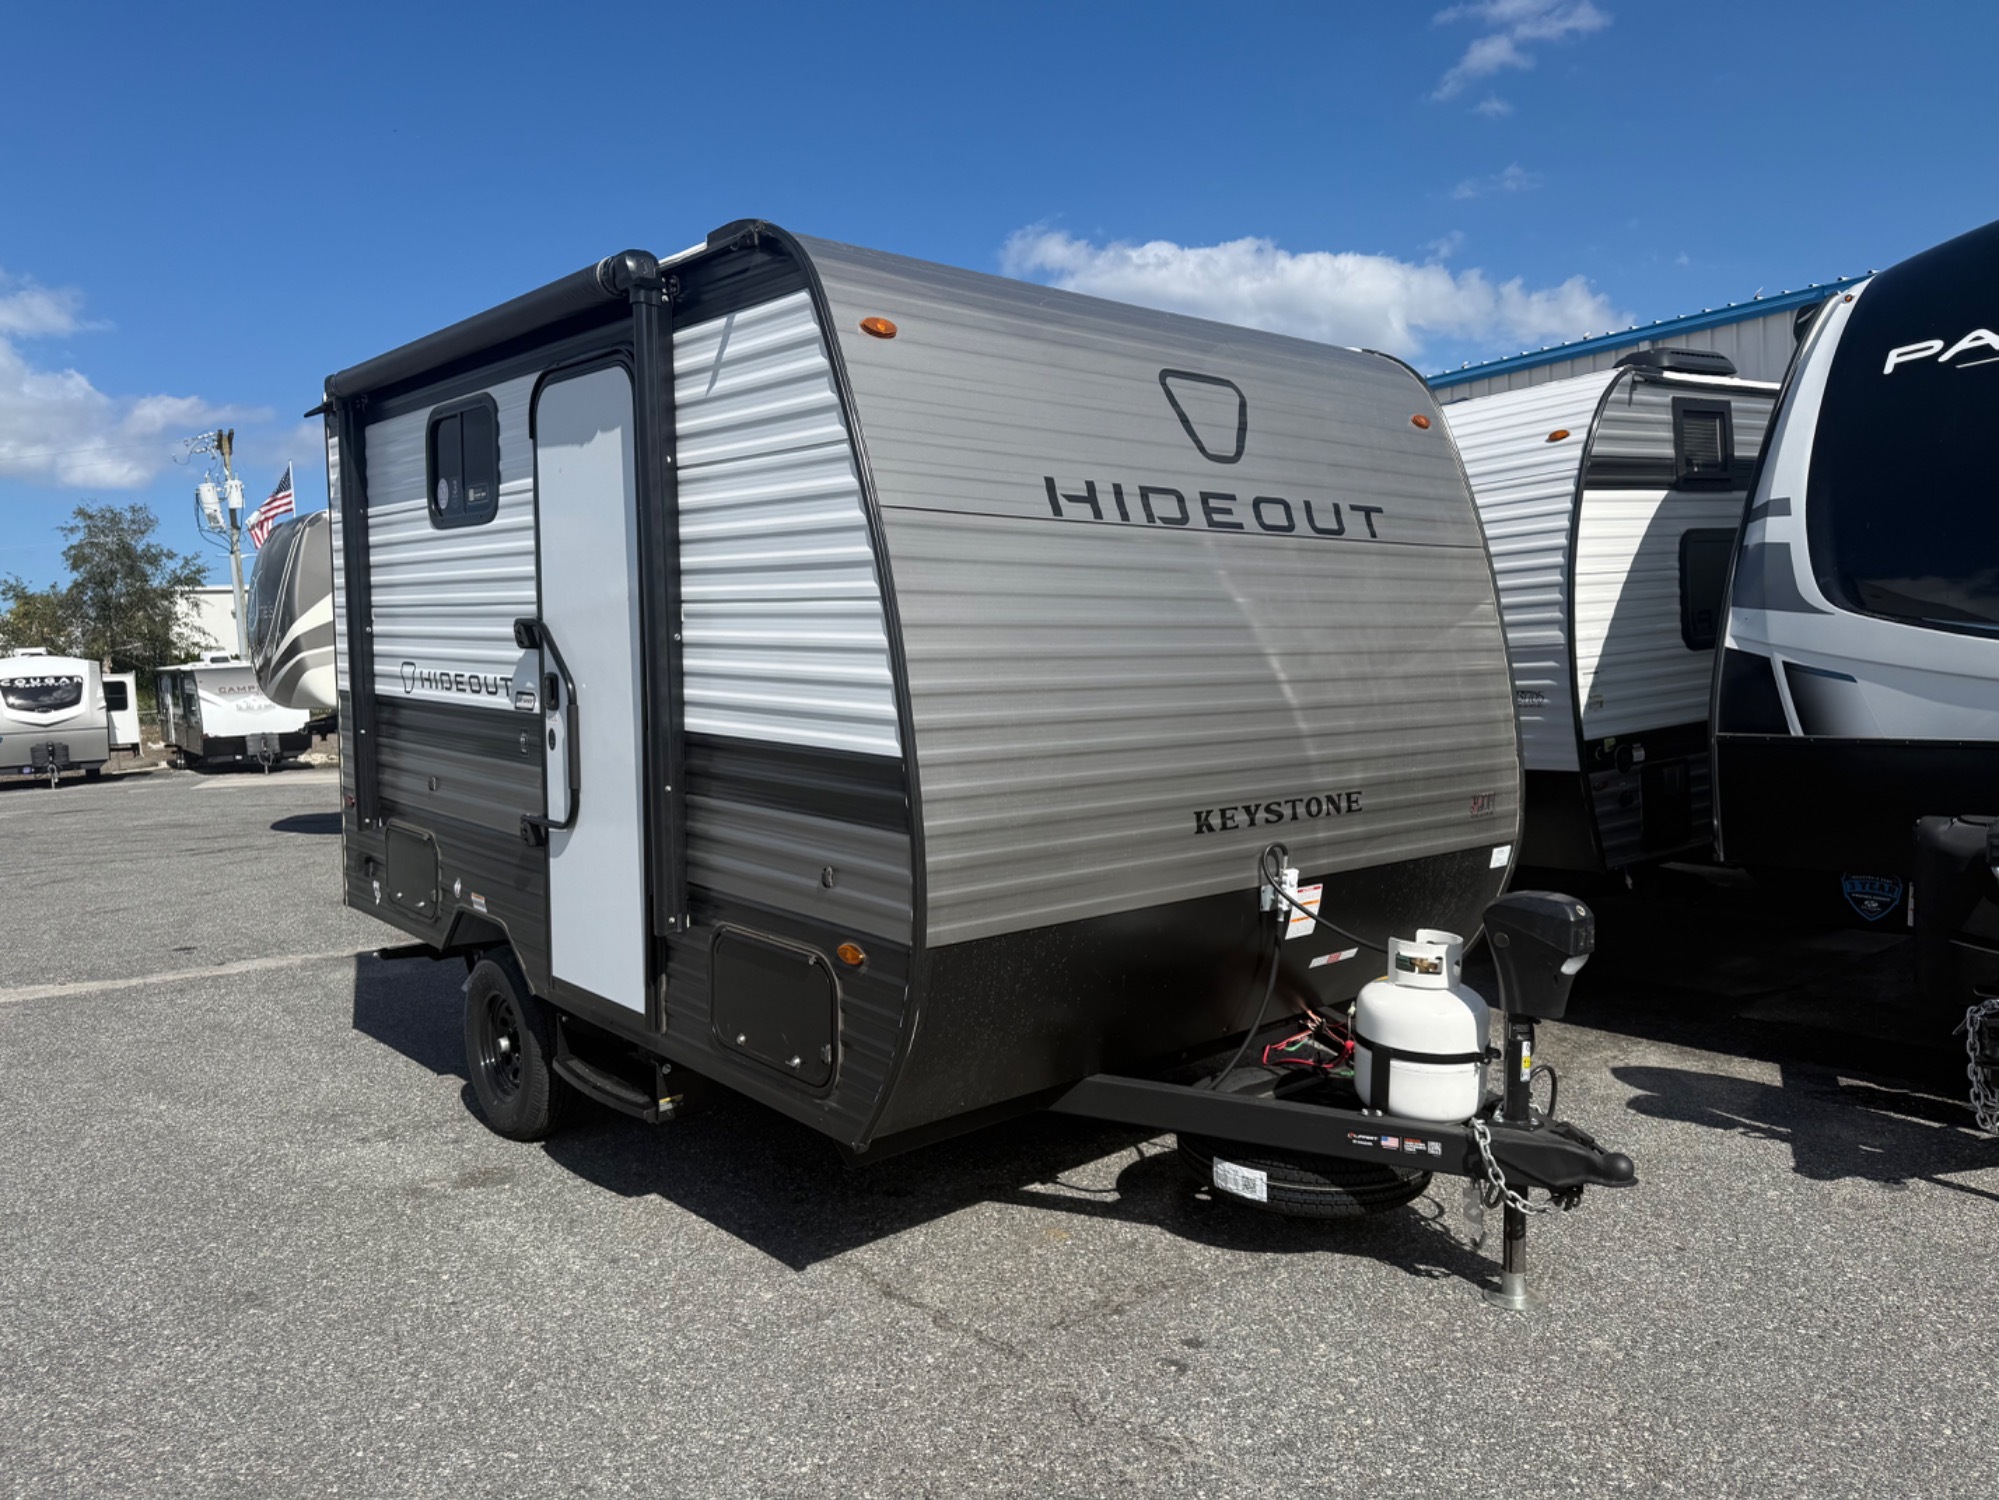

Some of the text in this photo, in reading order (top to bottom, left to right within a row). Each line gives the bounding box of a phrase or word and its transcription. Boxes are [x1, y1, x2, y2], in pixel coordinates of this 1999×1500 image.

[1044, 476, 1384, 539] HIDEOUT
[0, 676, 82, 687] COUGAR
[218, 684, 261, 695] CAMP
[419, 670, 513, 697] HIDEOUT
[1193, 791, 1363, 835] KEYSTONE
